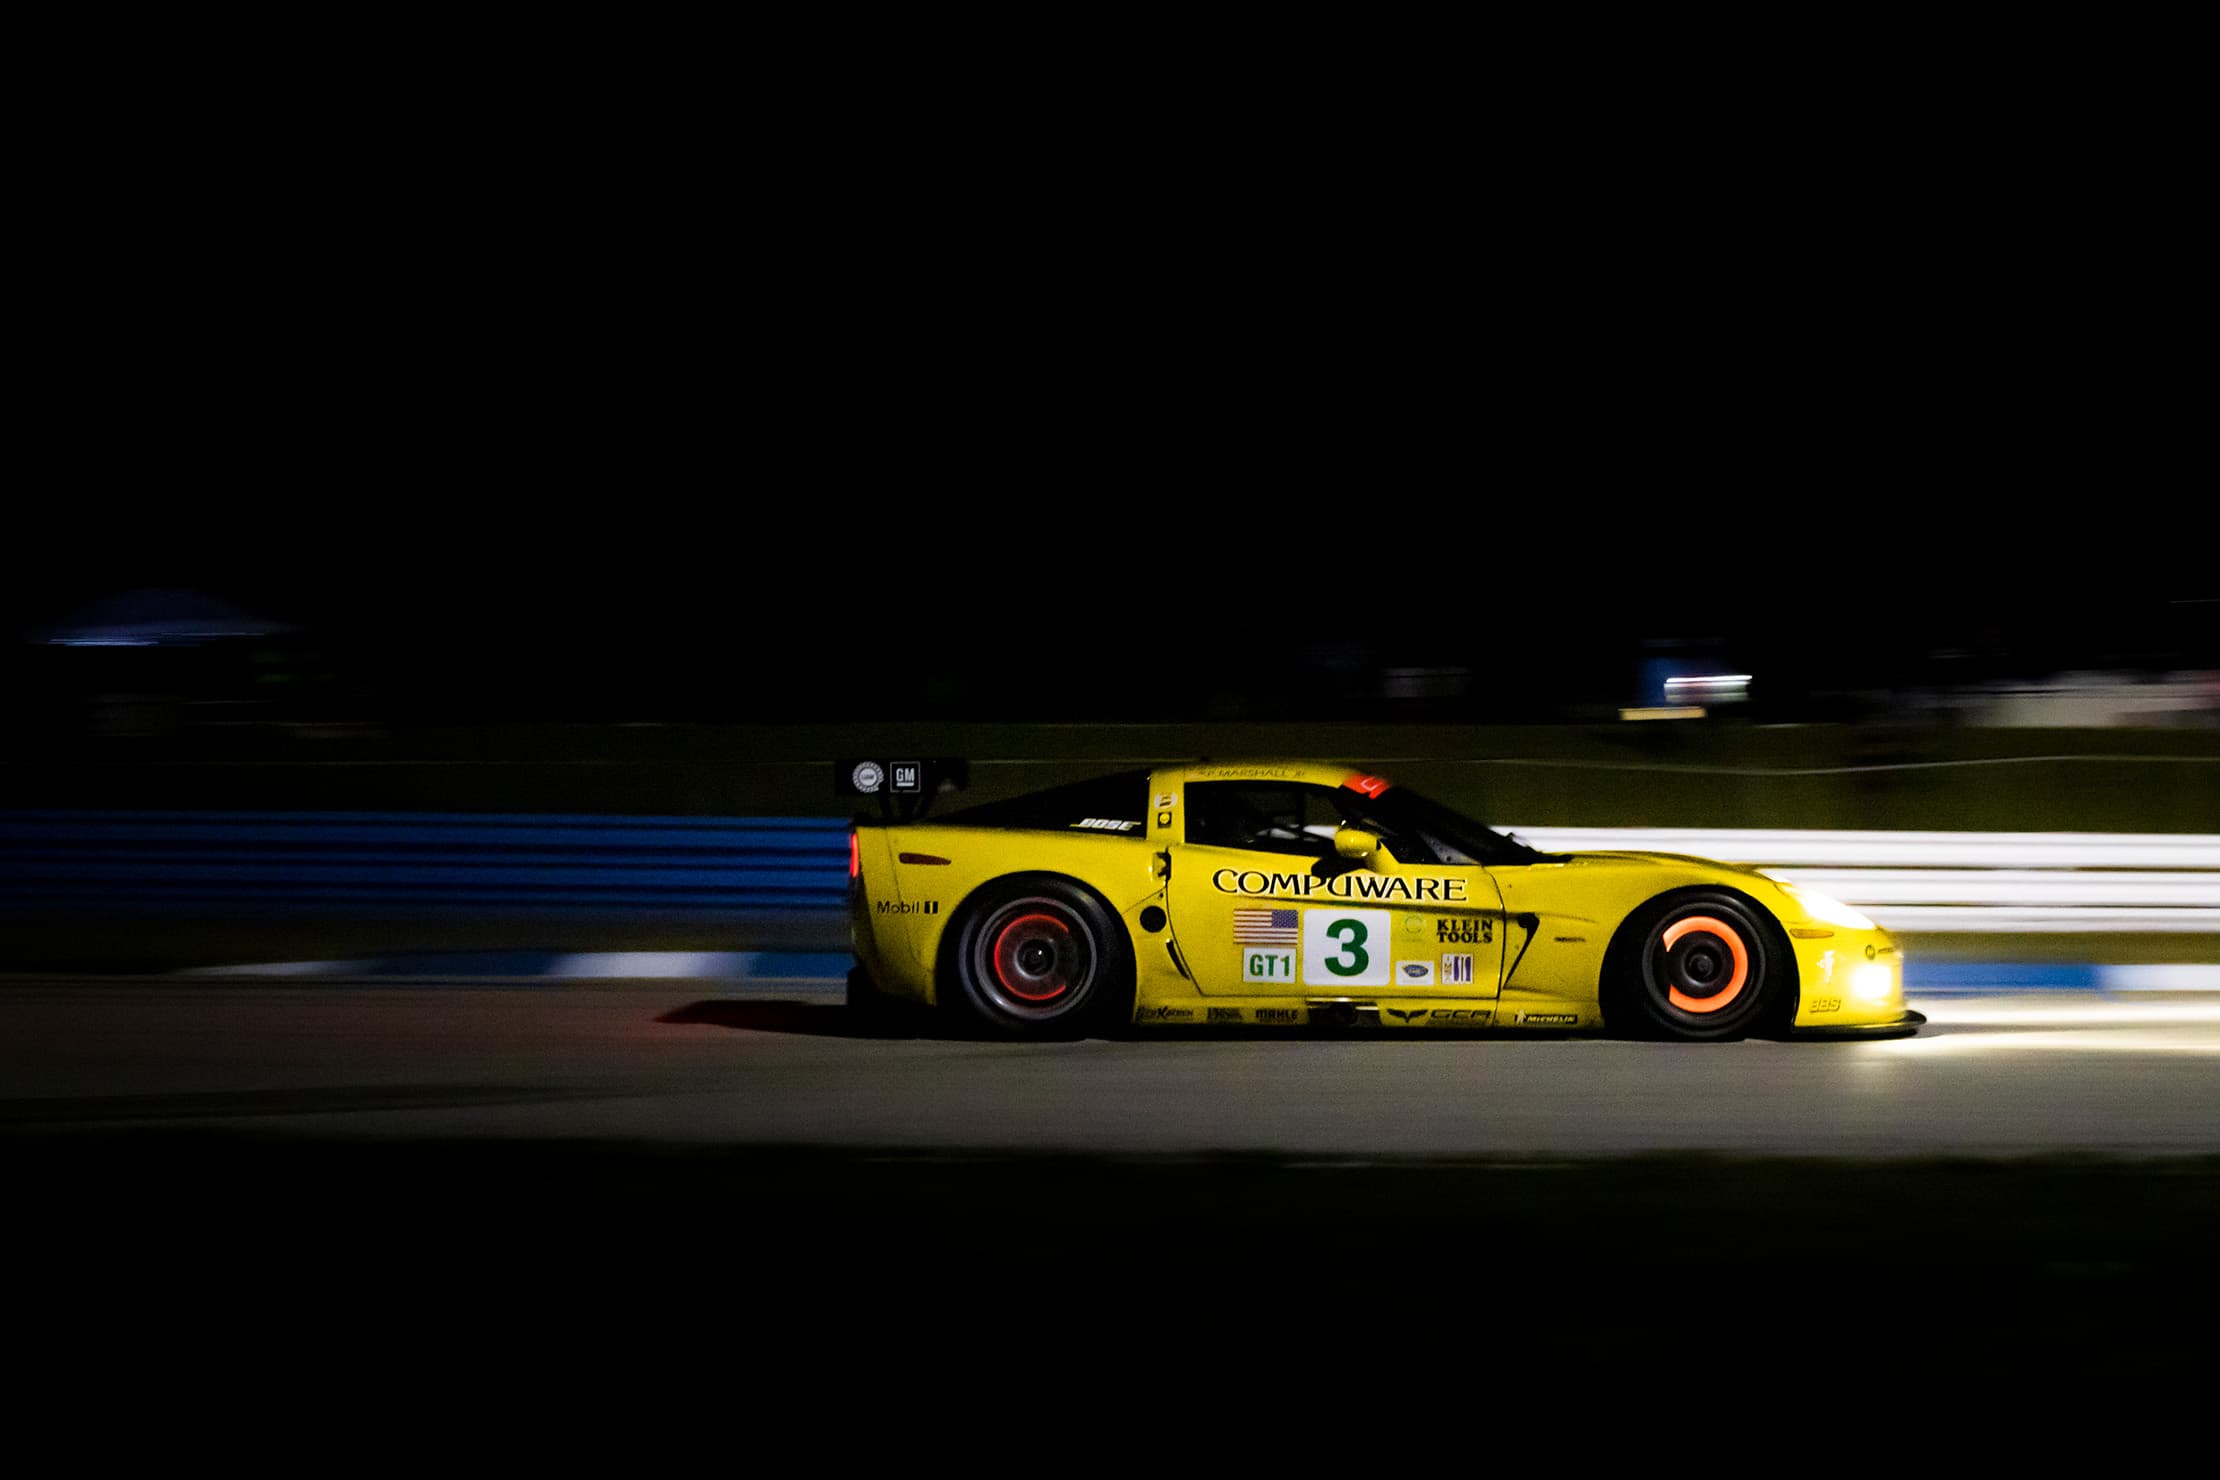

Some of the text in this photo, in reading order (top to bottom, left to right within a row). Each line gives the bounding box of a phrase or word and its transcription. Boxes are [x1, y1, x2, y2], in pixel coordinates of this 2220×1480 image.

[895, 767, 915, 783] GM
[1212, 868, 1467, 901] COMPUWARE
[877, 900, 939, 914] Mobil 1
[1437, 919, 1493, 931] KLEIN
[1437, 931, 1493, 943] TOOLS
[1324, 918, 1370, 977] 3
[1250, 954, 1291, 977] GT1
[1256, 1009, 1298, 1020] MAHLE
